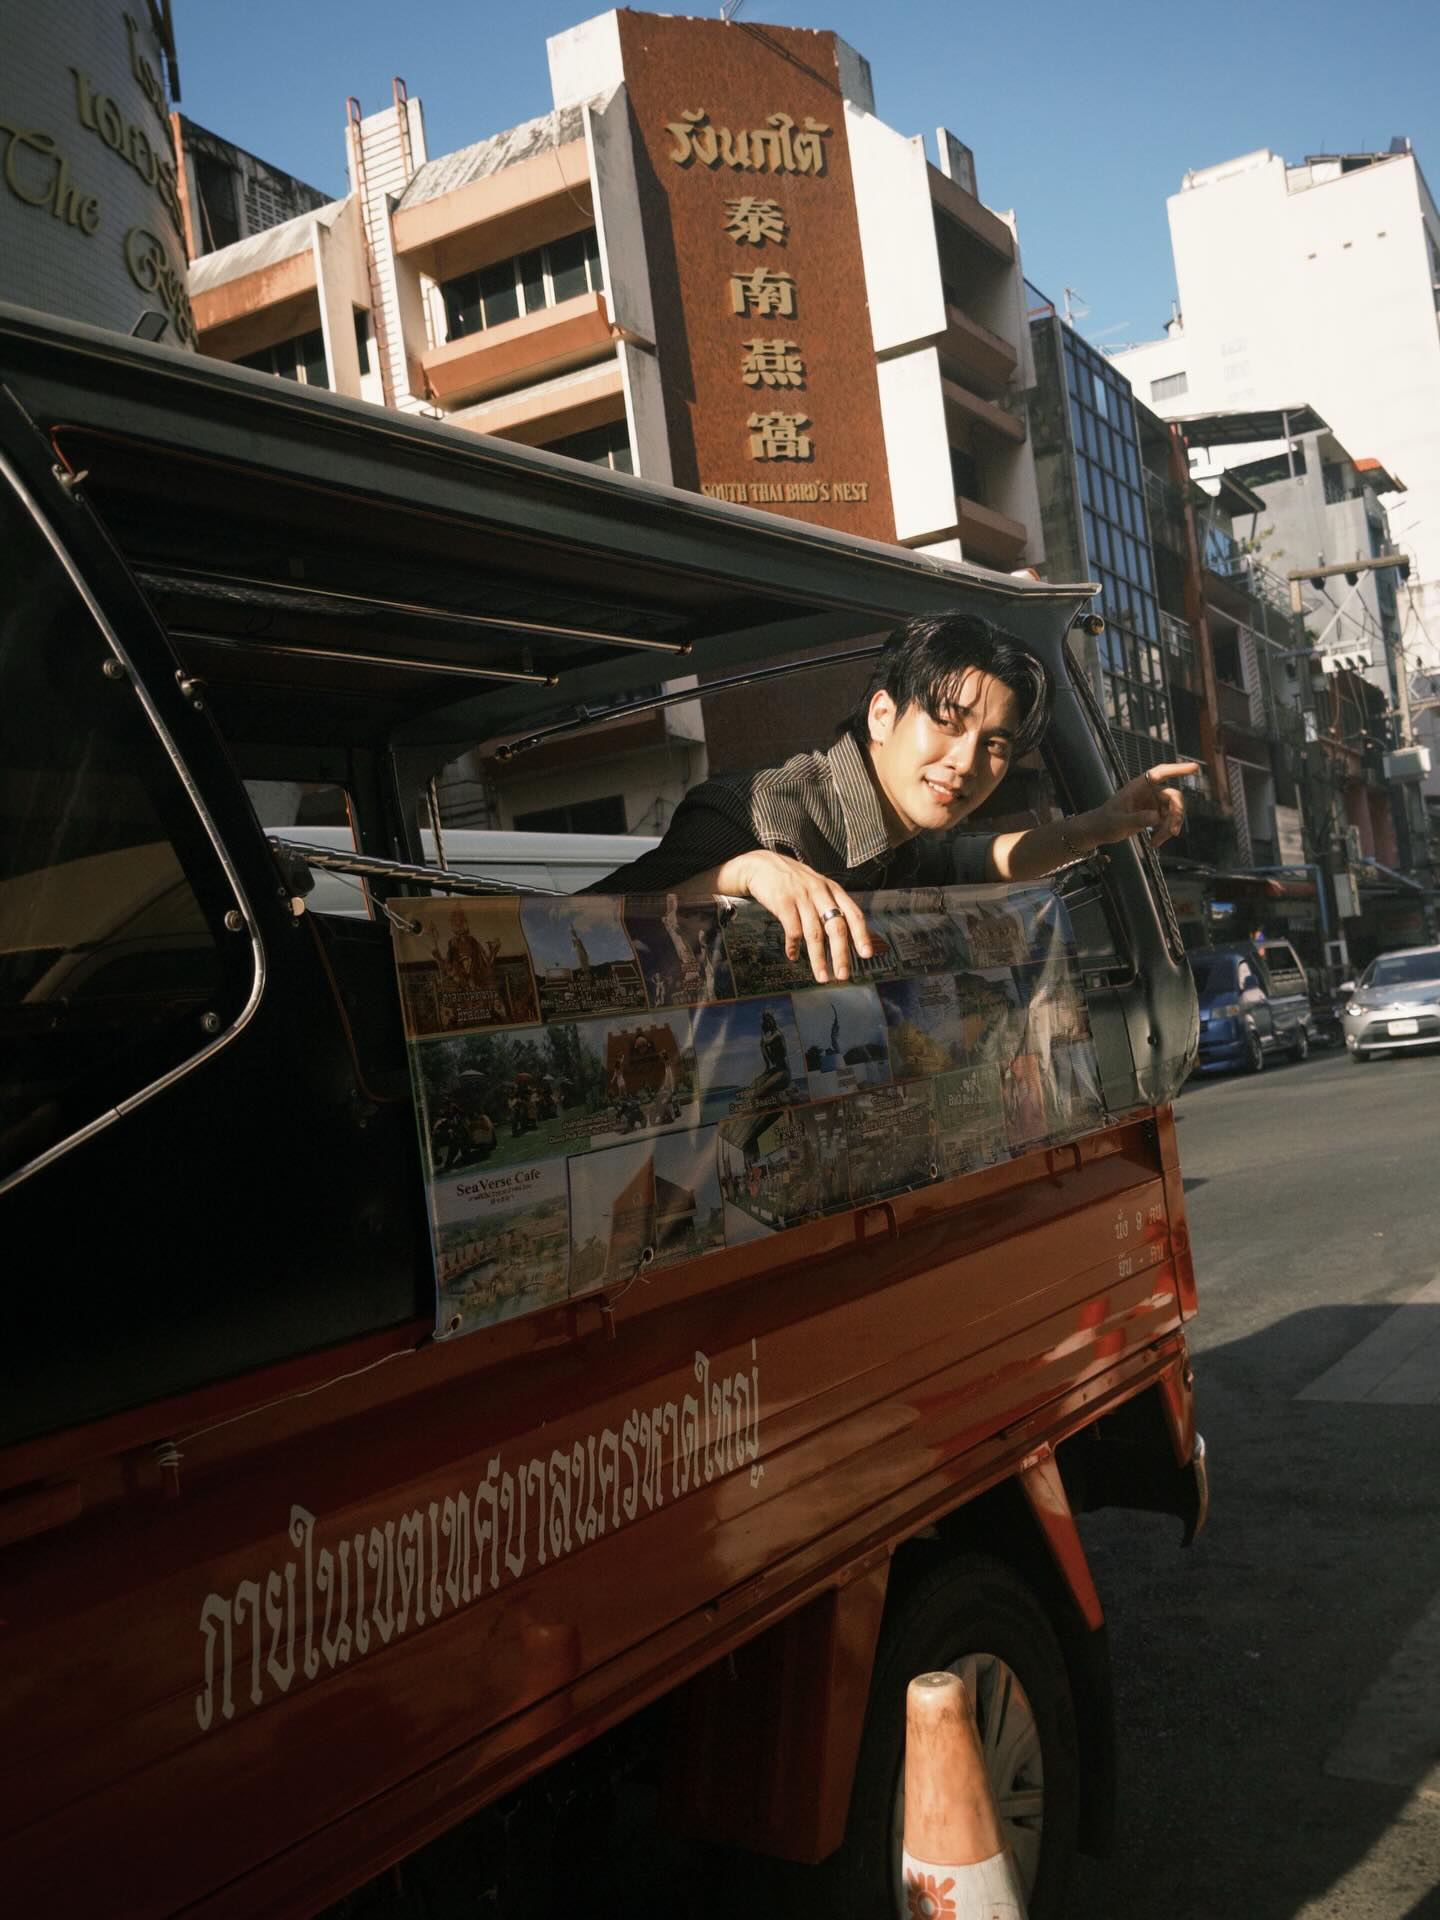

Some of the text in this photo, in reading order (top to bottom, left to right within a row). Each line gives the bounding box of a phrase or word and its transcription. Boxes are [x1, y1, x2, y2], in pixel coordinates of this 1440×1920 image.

[0, 119, 100, 237] The
[665, 107, 831, 174] รังนกใต้
[722, 195, 811, 462] 泰南燕窩
[751, 482, 784, 502] THAI
[785, 479, 830, 502] BIRD'S
[832, 482, 869, 502] NEST
[196, 1338, 764, 1731] ภายในเขตเทศบาลนครหาดใหญ่
